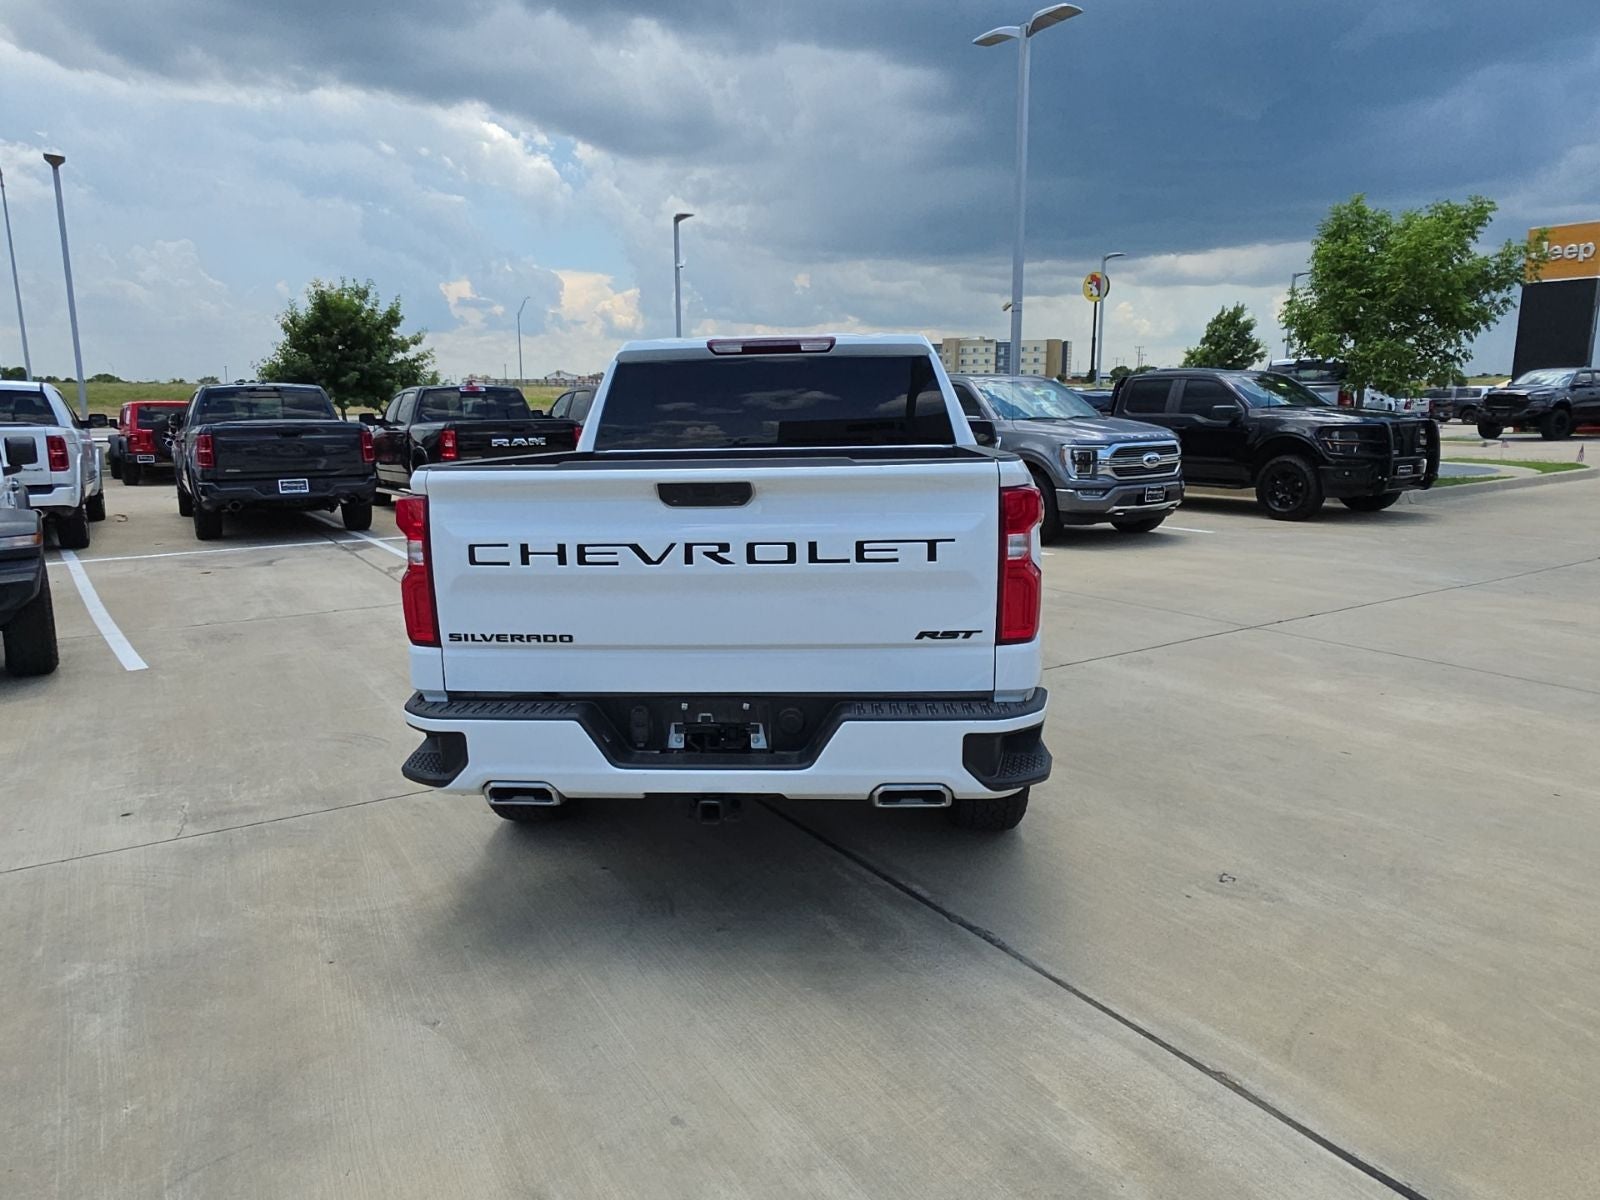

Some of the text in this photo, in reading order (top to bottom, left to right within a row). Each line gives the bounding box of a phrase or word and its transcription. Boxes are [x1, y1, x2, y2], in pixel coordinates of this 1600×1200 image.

[491, 437, 547, 447] RAM
[468, 538, 956, 566] CHEVROLET
[448, 632, 574, 643] SILVERADO
[914, 629, 983, 640] RST
